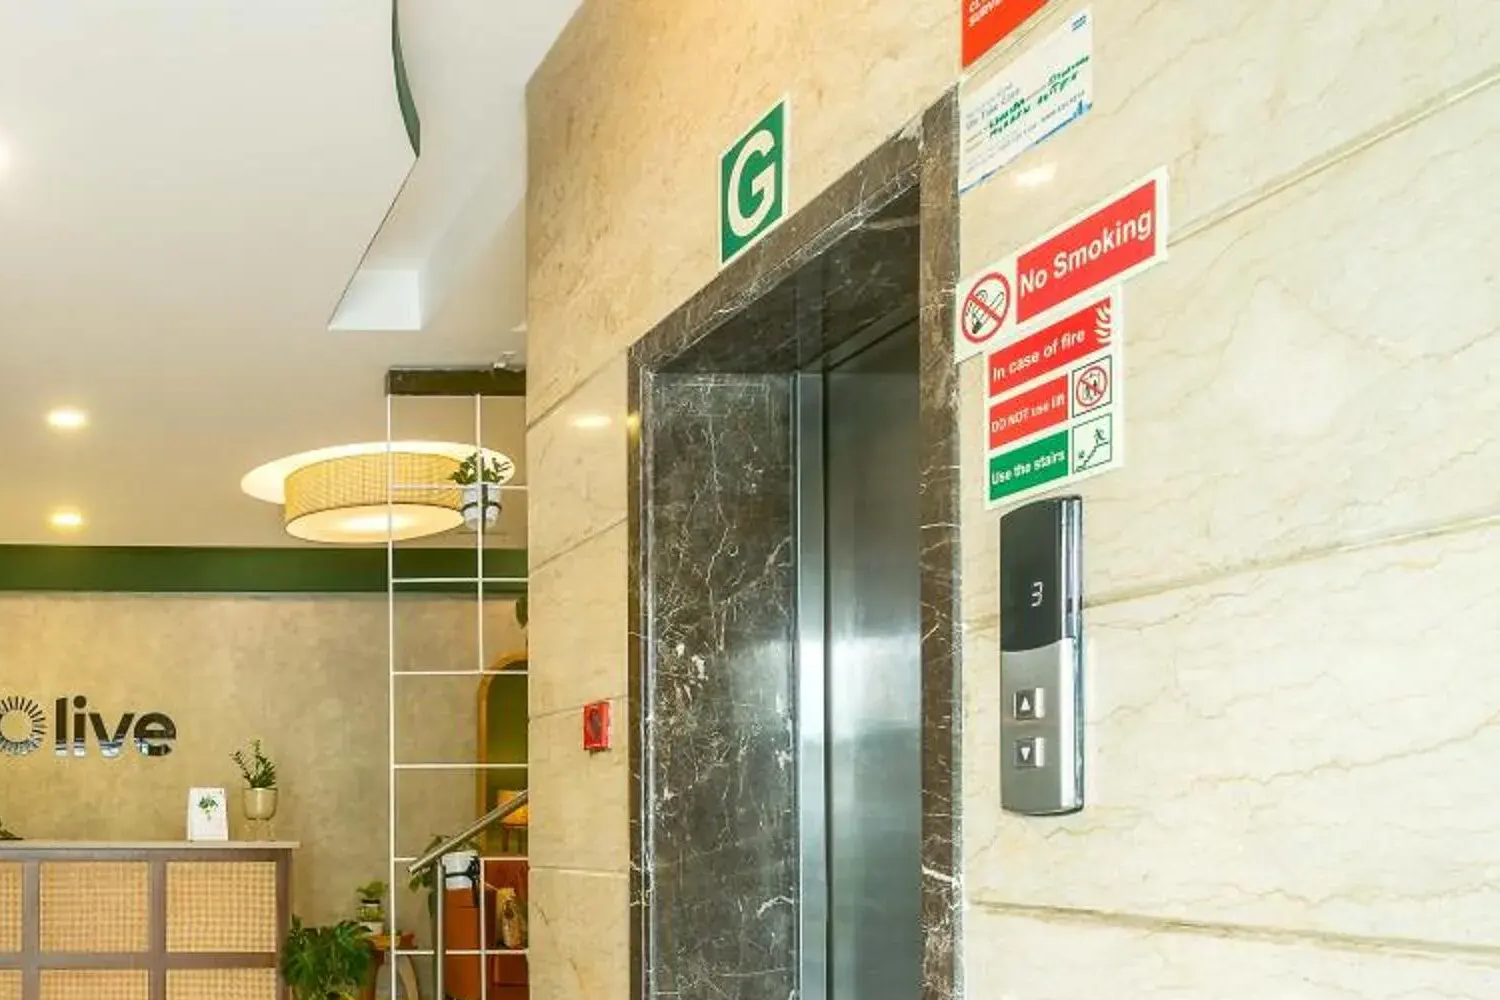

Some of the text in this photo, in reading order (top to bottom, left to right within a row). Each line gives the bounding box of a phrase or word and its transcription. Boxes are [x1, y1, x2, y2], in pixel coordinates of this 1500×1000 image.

[728, 130, 775, 237] G
[1020, 210, 1152, 296] No Smoking
[993, 329, 1086, 381] In case of fire
[990, 416, 1007, 433] DO
[1007, 407, 1030, 426] NOT
[1031, 402, 1049, 417] use
[991, 449, 1065, 485] Use the stairs
[1032, 582, 1043, 607] 3
